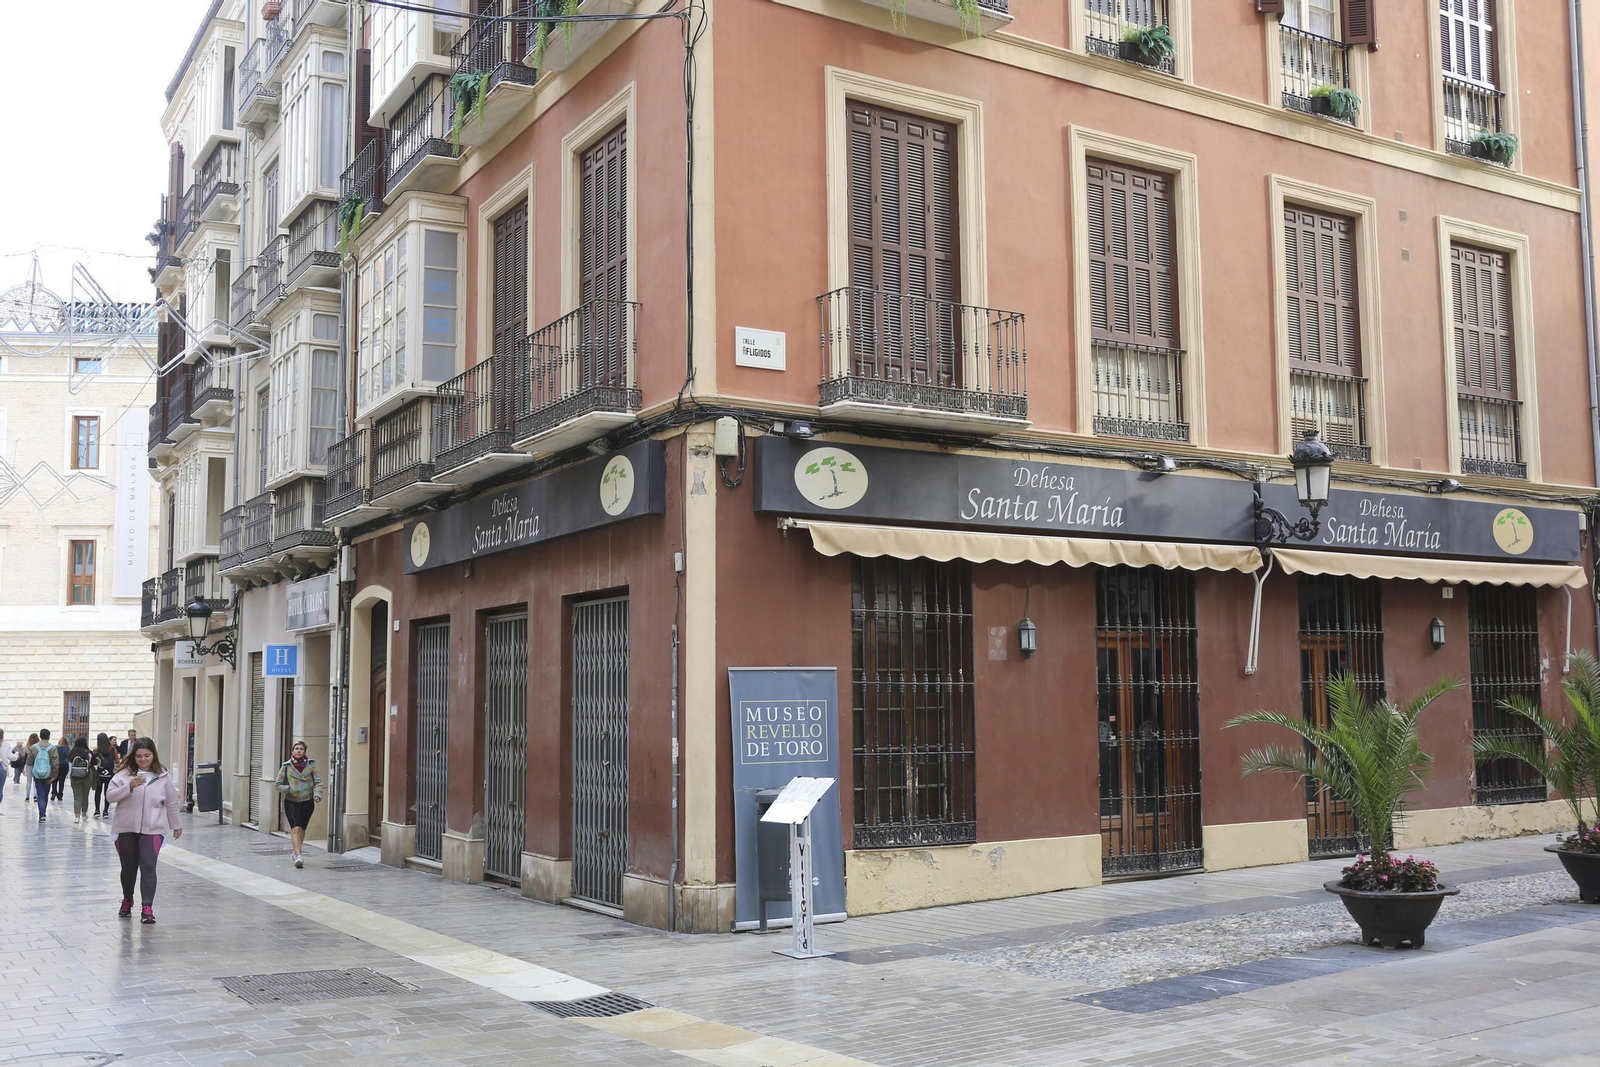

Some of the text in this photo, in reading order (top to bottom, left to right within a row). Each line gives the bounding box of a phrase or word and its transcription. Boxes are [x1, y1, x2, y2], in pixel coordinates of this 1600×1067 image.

[742, 346, 771, 358] AFLIGIDOS
[1014, 466, 1075, 491] Dehesa
[129, 508, 136, 521] DE
[491, 492, 518, 517] Dehesa
[961, 487, 1125, 528] Santa María
[1359, 498, 1405, 518] Dehesa
[472, 507, 540, 554] Santa María
[1322, 516, 1441, 549] Santa María
[127, 528, 136, 566] MUSEO
[288, 596, 303, 617] HOTEL
[274, 648, 290, 666] H
[745, 706, 822, 722] MUSEO
[746, 723, 823, 740] REVELLO
[746, 740, 823, 757] DE TORO
